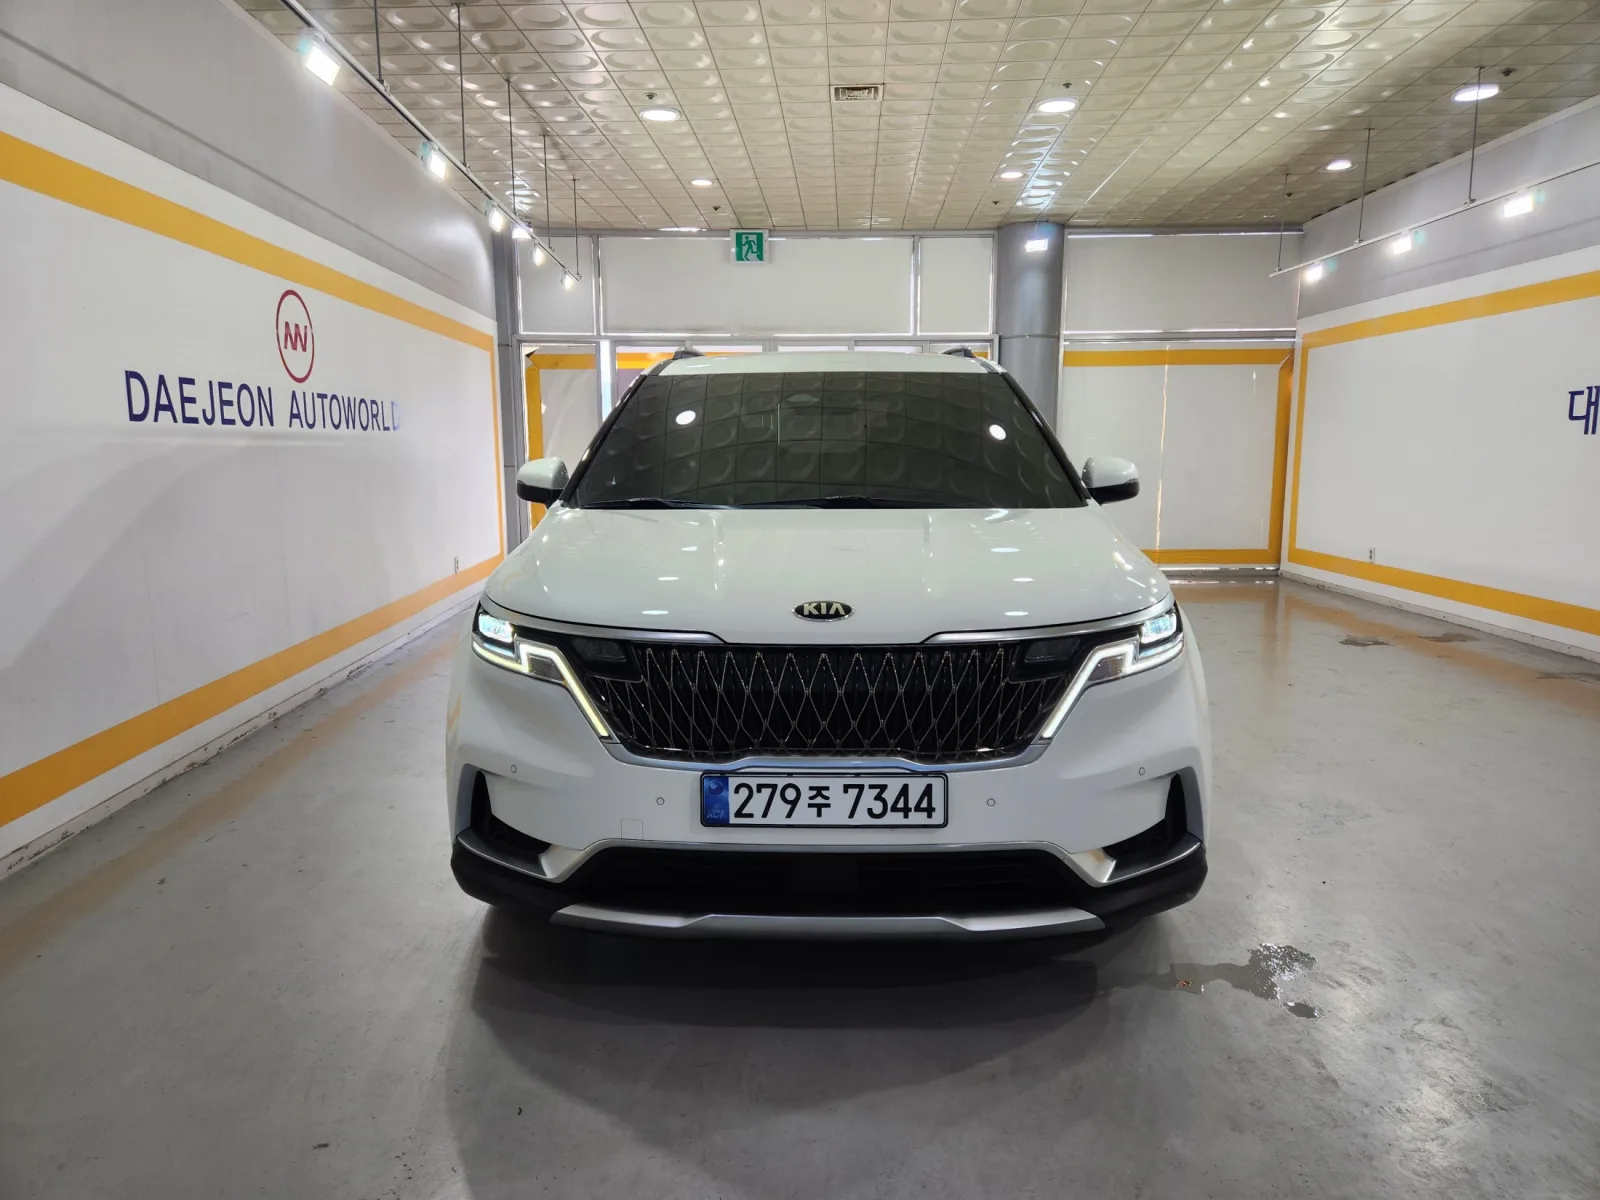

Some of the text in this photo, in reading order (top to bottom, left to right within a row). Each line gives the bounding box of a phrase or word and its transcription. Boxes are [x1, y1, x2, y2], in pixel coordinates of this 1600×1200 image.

[124, 370, 400, 432] DAEJEON AUTOWORLD
[1568, 385, 1600, 435] 대
[803, 602, 846, 616] KIA
[733, 782, 936, 819] 279주 7344
